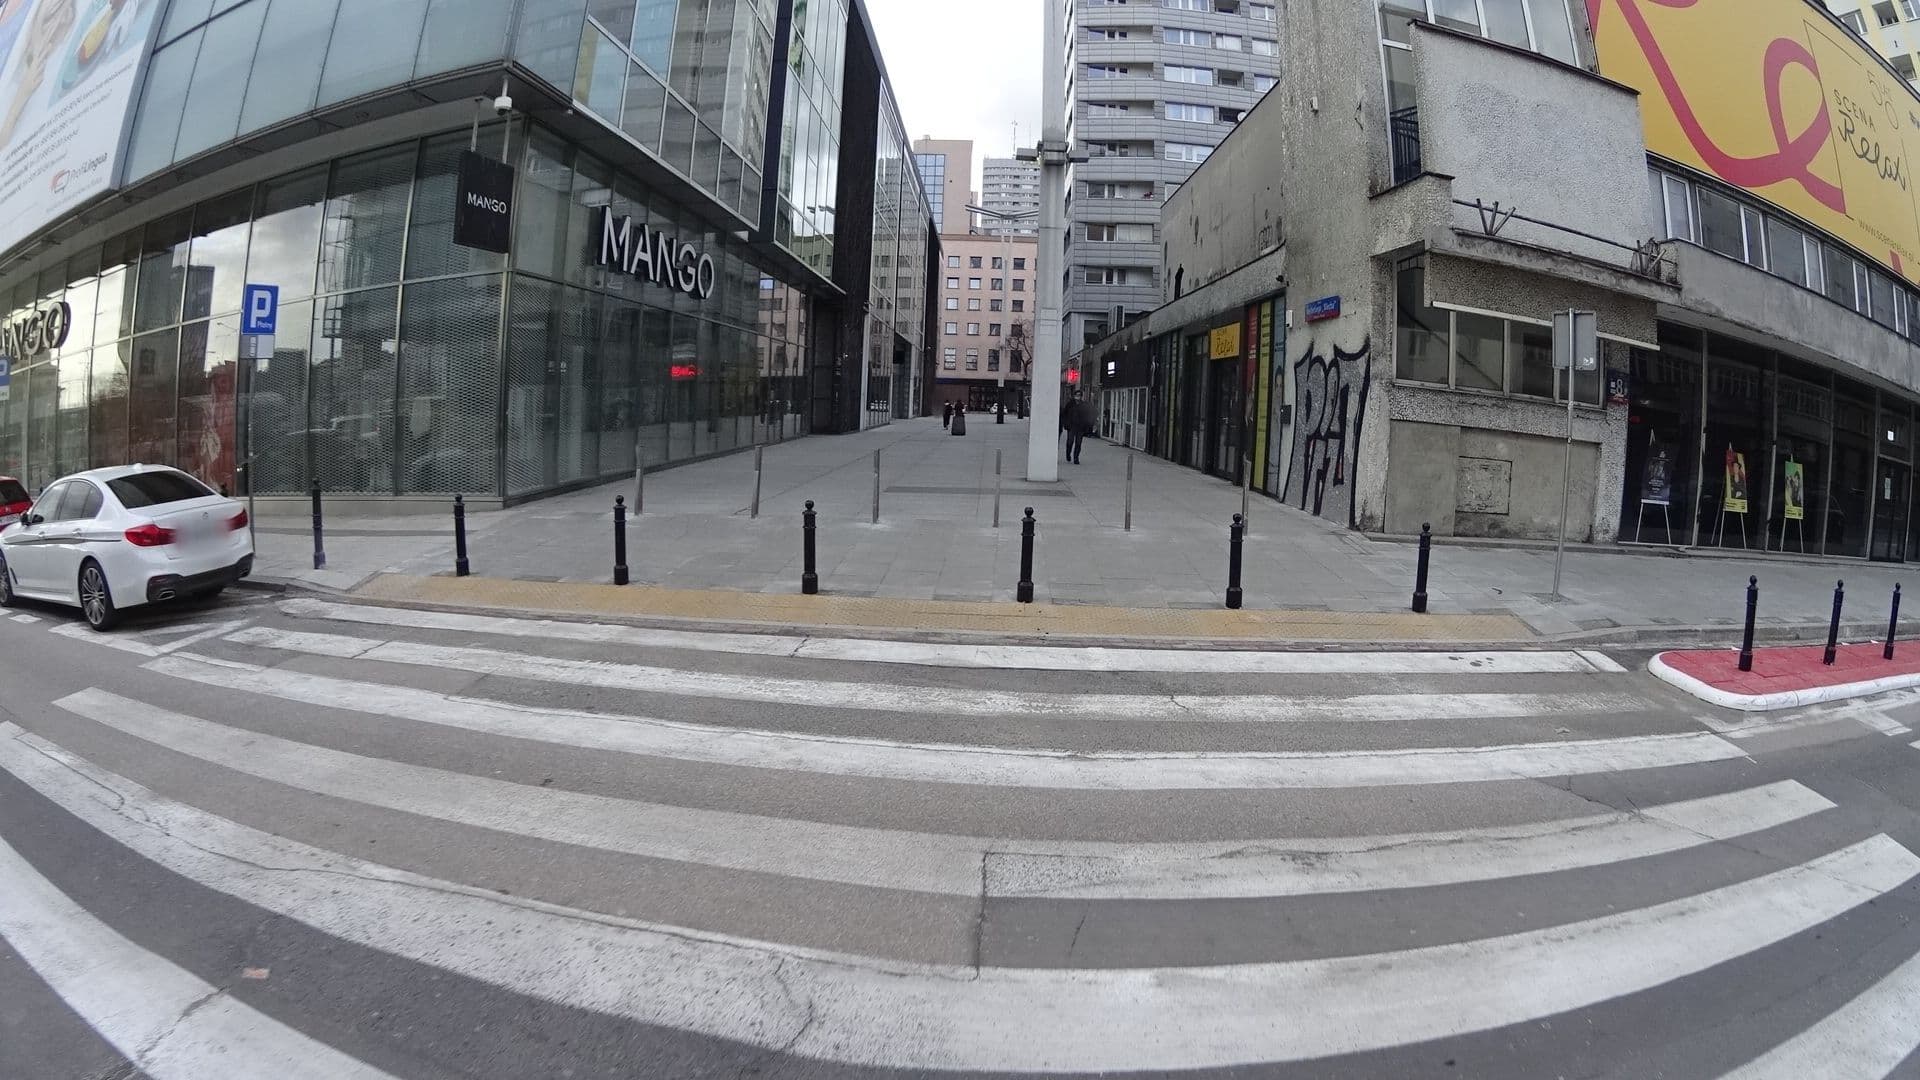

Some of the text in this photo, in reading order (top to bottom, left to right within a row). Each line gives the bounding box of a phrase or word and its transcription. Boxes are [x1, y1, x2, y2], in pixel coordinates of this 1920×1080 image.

[1834, 89, 1876, 133] SCENA
[1838, 109, 1906, 191] Relax
[467, 191, 507, 214] MANGO
[602, 204, 715, 300] MANGO
